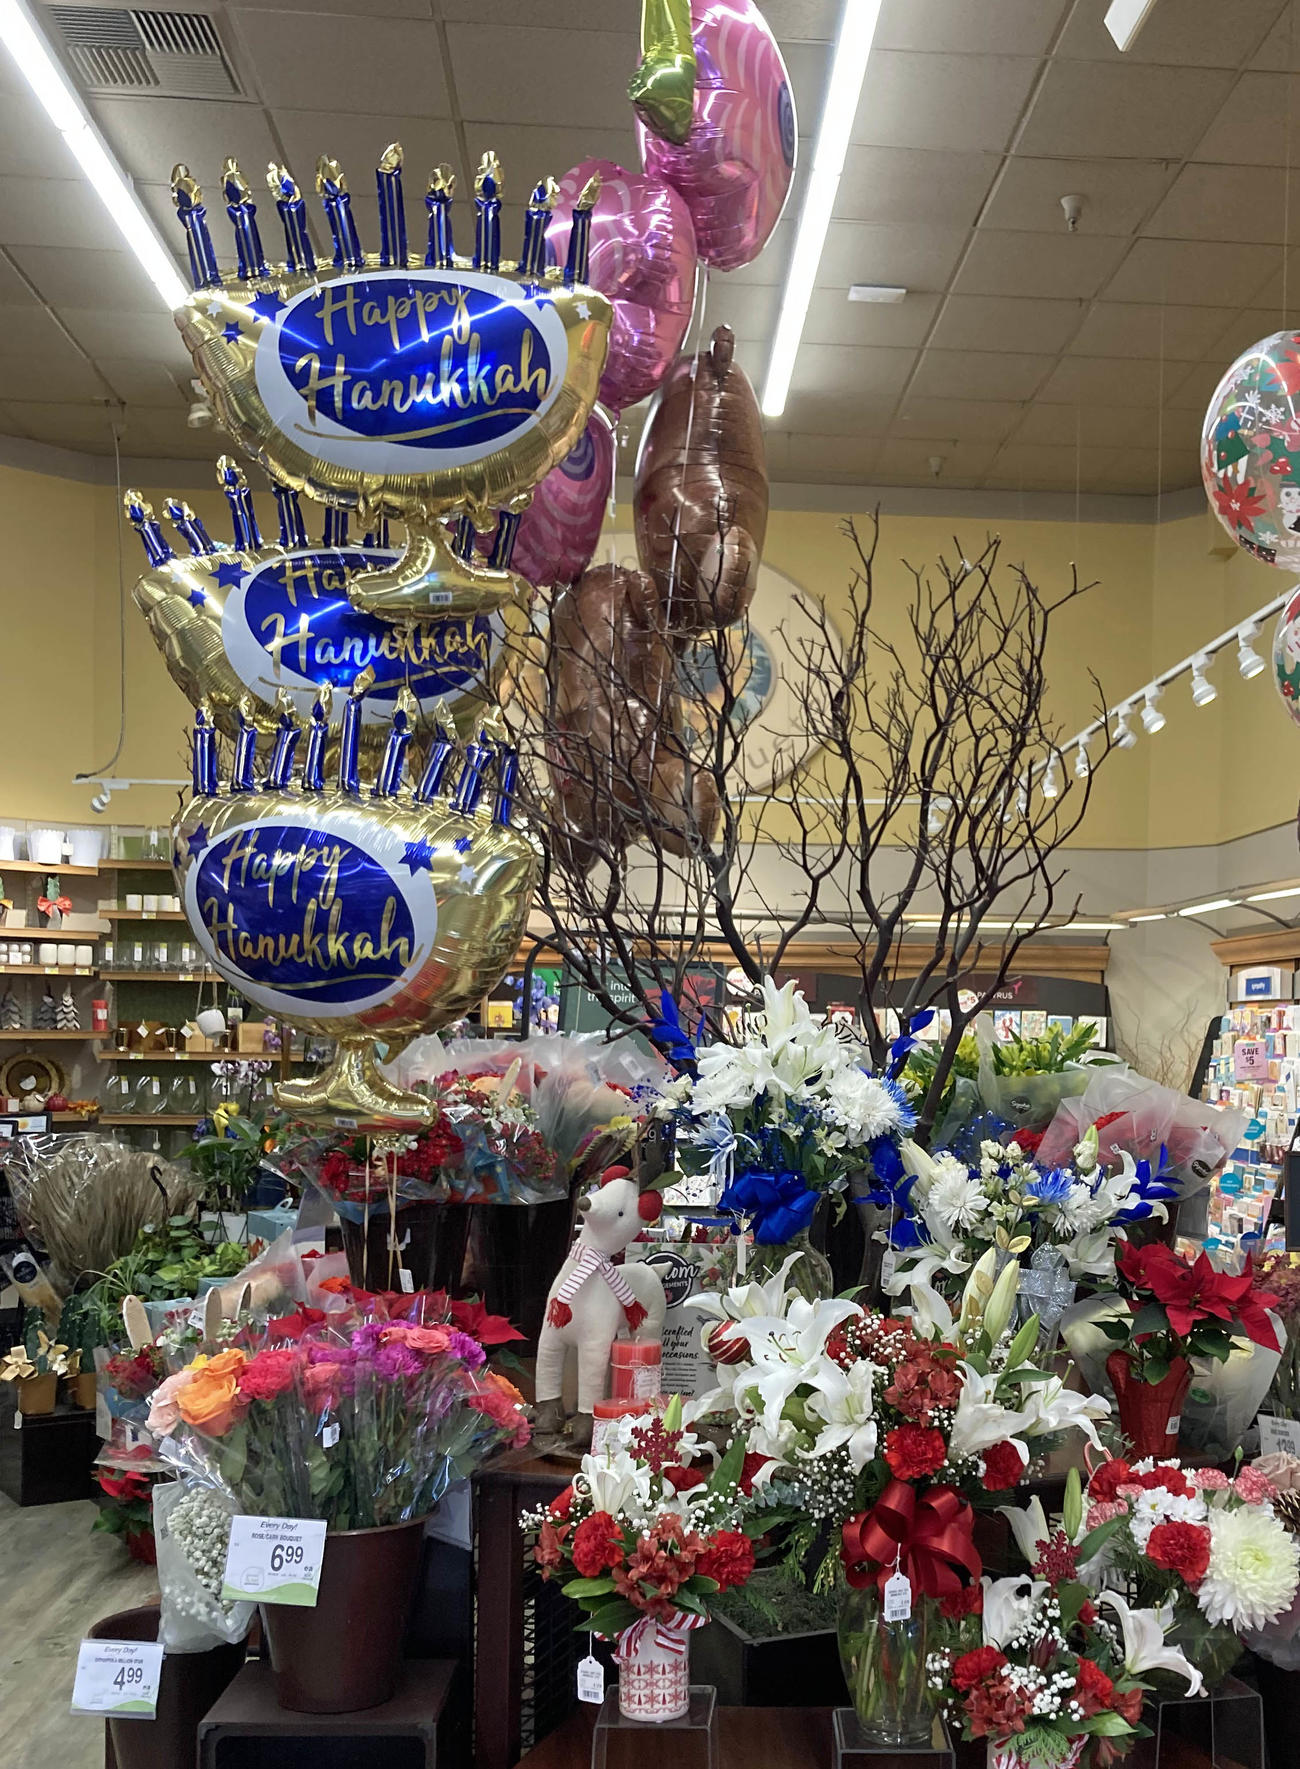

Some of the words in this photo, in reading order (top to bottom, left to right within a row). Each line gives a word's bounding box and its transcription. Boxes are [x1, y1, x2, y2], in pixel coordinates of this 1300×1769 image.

[312, 285, 472, 350] Happy
[294, 327, 558, 426] Hanukkah
[221, 828, 352, 909] Happy
[203, 897, 425, 972] Hanukkah
[1241, 1047, 1260, 1056] SAVE
[260, 1521, 280, 1531] Every
[281, 1522, 298, 1531] Day!
